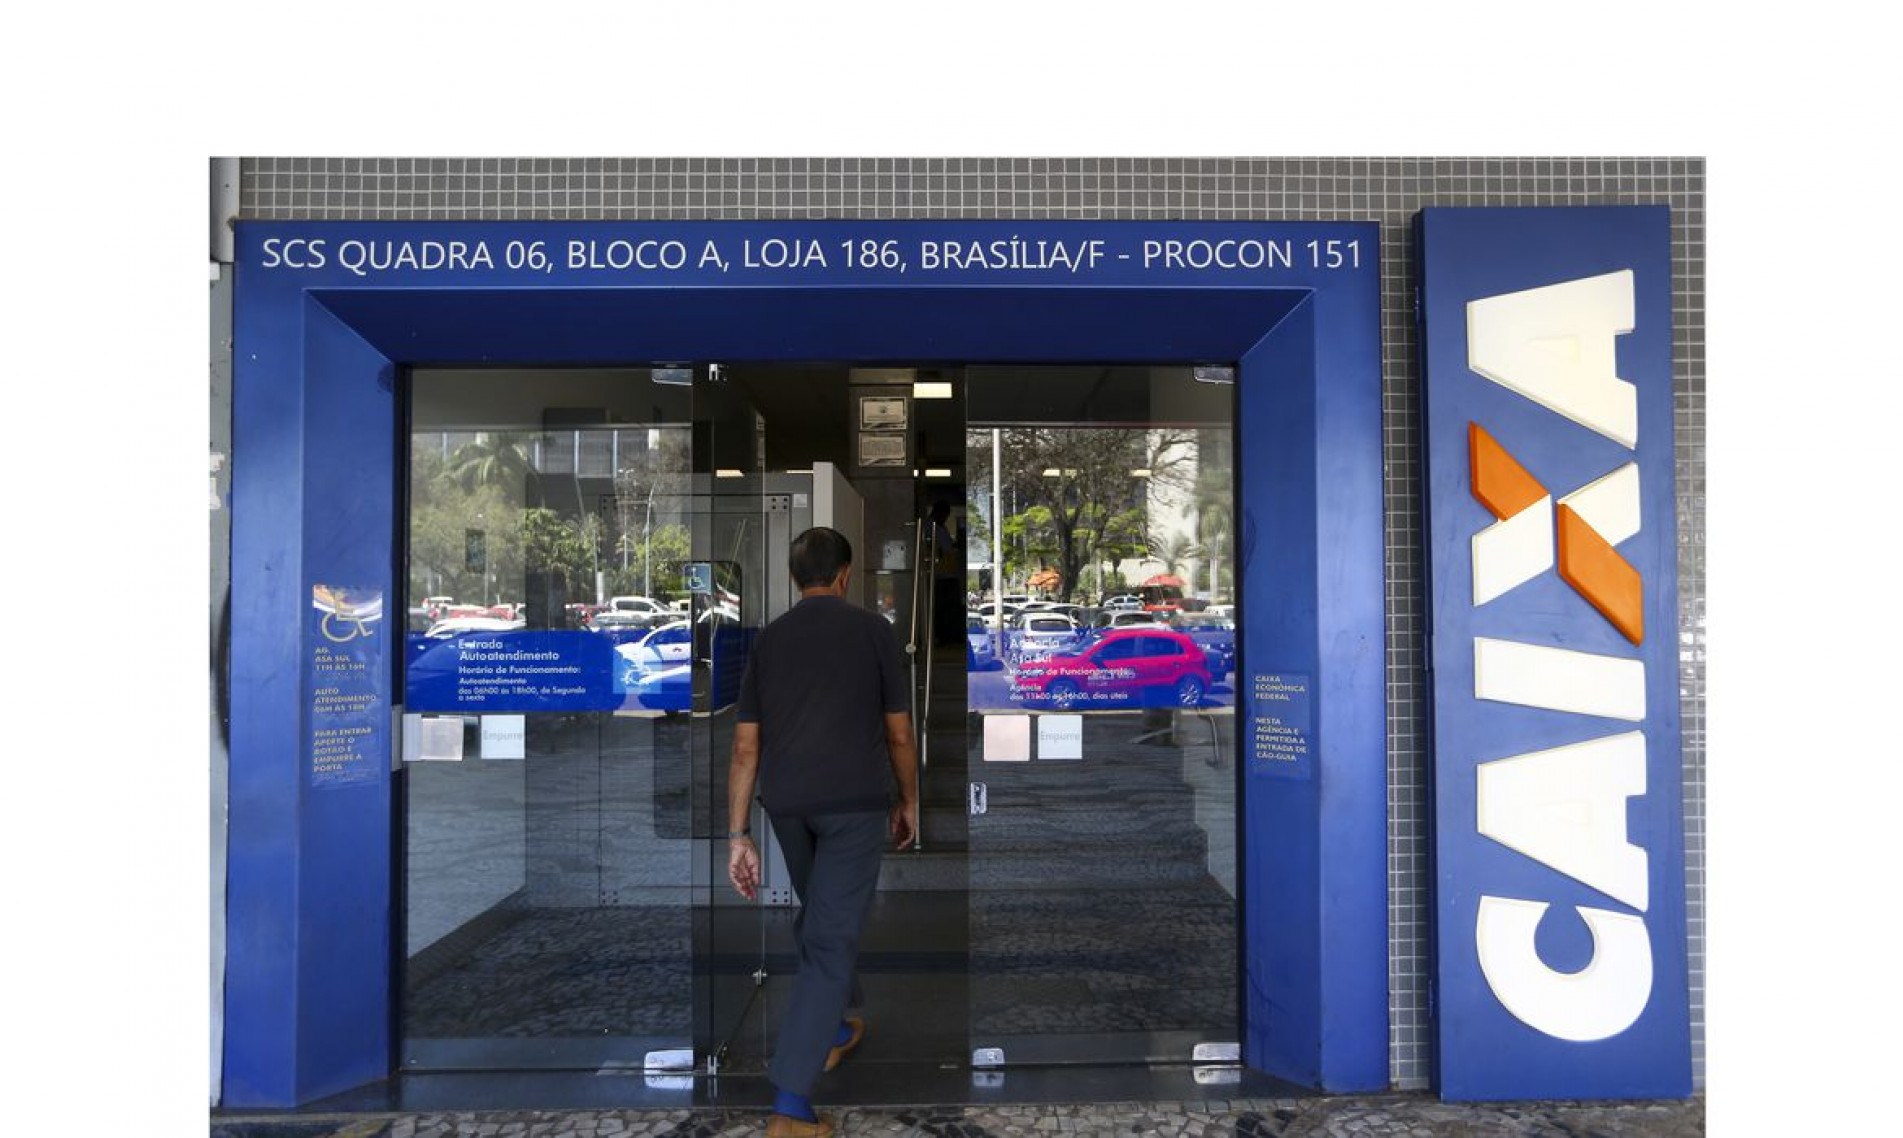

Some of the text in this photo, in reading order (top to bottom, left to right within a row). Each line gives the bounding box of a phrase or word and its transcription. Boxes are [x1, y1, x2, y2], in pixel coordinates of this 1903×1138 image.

[262, 238, 326, 269] SCS
[339, 240, 494, 276] QUADRA
[505, 240, 554, 274] 06,
[568, 240, 687, 269] BLOCO
[698, 240, 730, 273] A,
[744, 239, 827, 268] LOJA
[841, 240, 907, 274] 186,
[921, 234, 1105, 273] BRASÍLIA/F
[1144, 239, 1292, 269] PROCON
[1307, 240, 1359, 269] 151
[458, 639, 503, 650] Entrada
[315, 654, 350, 663] ASA SUL
[460, 650, 560, 661] Autoatendimento
[1466, 268, 1654, 1043] CAIXA
[459, 664, 582, 674] Horário de Funcionamento:
[1046, 667, 1058, 676] de
[459, 677, 527, 685] Autoatendimento
[315, 688, 339, 696] AUTO
[458, 686, 472, 695] das
[474, 686, 499, 695] 06h00
[541, 687, 551, 695] de
[552, 686, 587, 697] Segunda
[1255, 682, 1305, 692] ECONÔMICA
[315, 694, 377, 704] ATENDIMENTO
[466, 694, 486, 702] sexta
[1009, 691, 1023, 700] das
[1092, 691, 1109, 700] dias
[1255, 693, 1289, 701] FEDERAL
[315, 727, 372, 738] PARA ENTRAR
[1256, 726, 1292, 735] AGÊNCIA
[313, 736, 355, 746] APERTE O
[482, 730, 523, 742] Empurre
[1040, 730, 1081, 743] Empurre
[1256, 734, 1306, 745] PERMITIDA A
[1256, 743, 1307, 754] ENTRADA DE
[313, 753, 363, 764] EMPURRE A
[313, 763, 343, 773] PORTA
